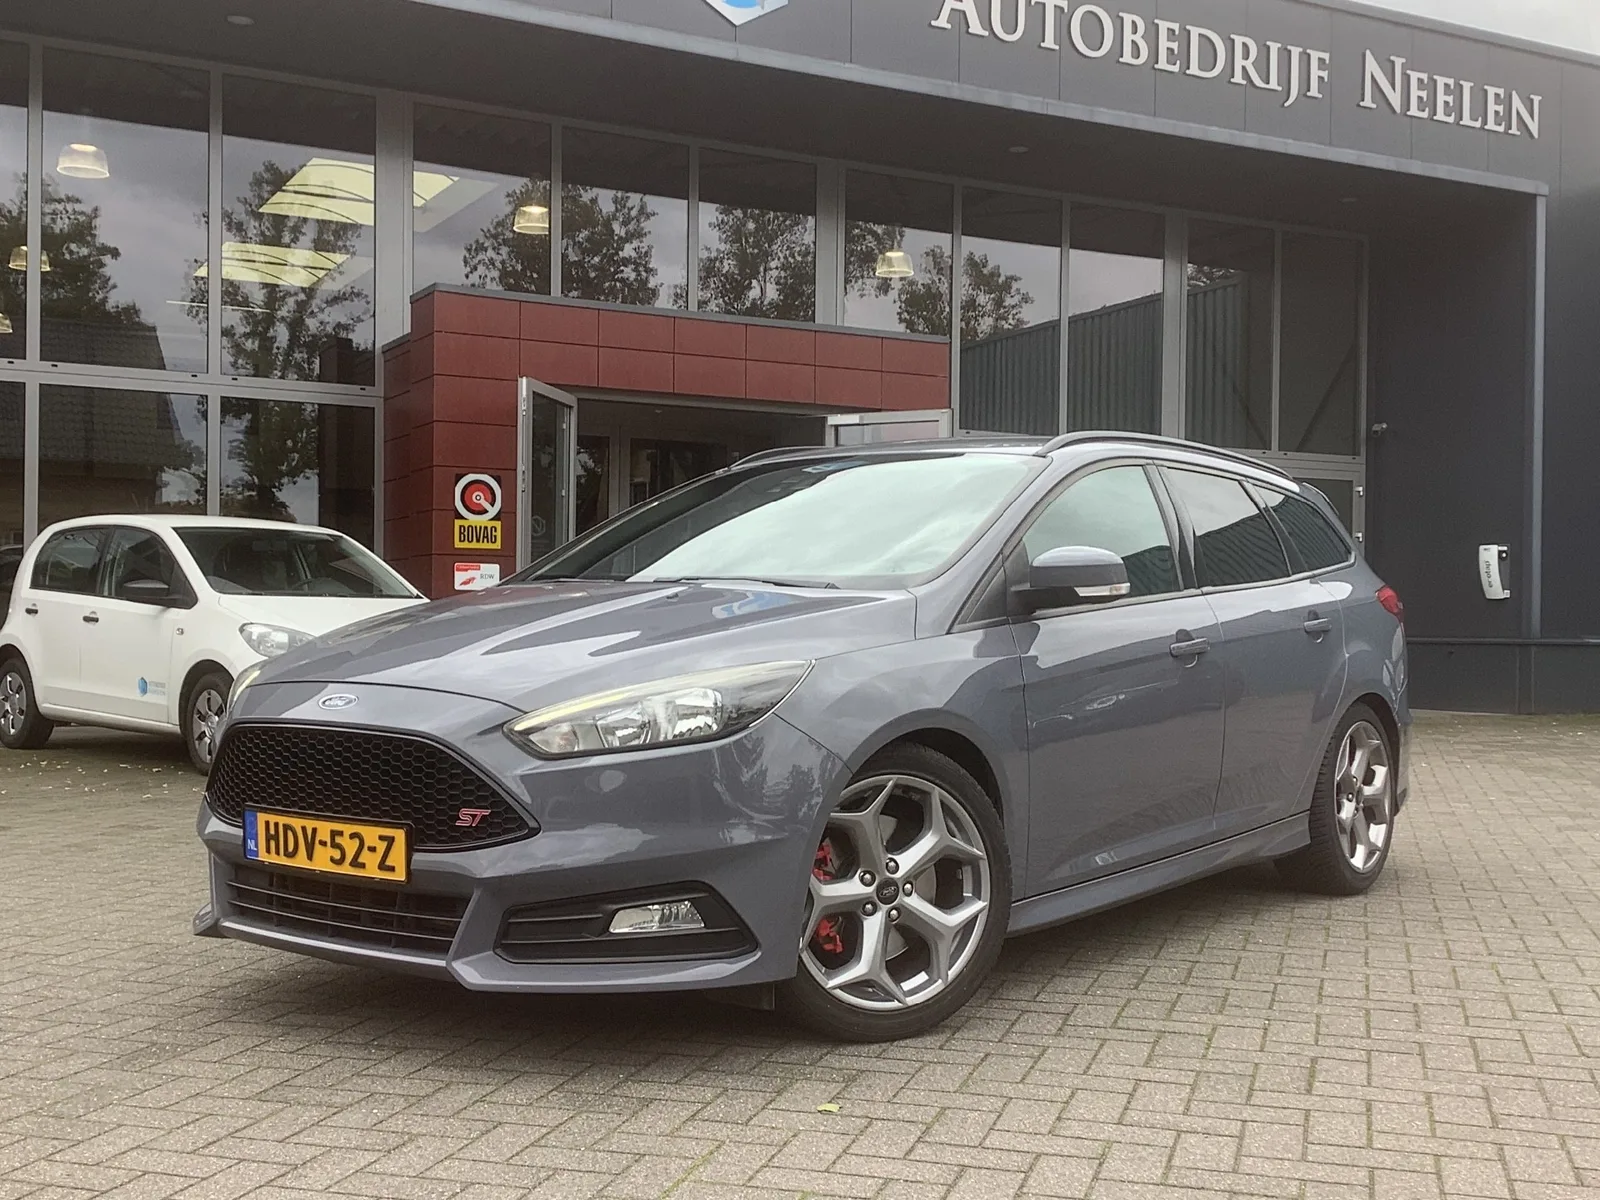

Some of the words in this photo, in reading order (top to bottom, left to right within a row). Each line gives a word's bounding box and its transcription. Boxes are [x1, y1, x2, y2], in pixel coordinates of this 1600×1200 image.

[930, 0, 1331, 108] AUTOBEDRIJF
[1358, 49, 1542, 139] NEELEN
[458, 524, 497, 544] BOVAG
[455, 808, 491, 827] ST
[247, 839, 257, 851] NL
[264, 819, 396, 873] HDV-52-Z
